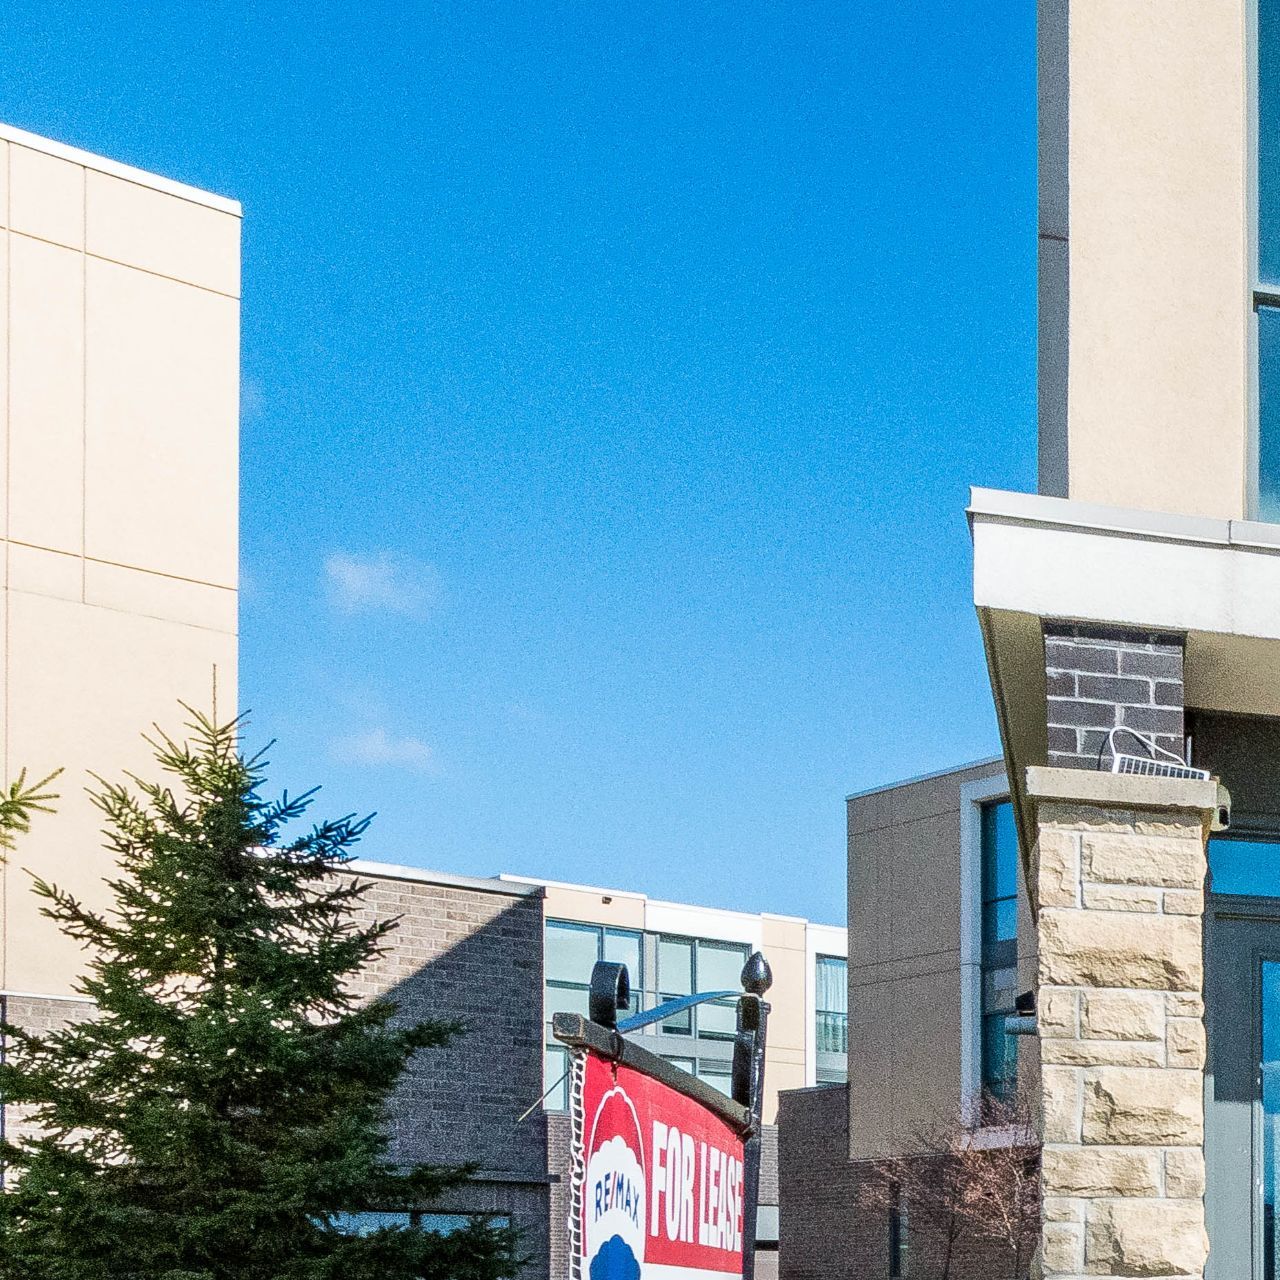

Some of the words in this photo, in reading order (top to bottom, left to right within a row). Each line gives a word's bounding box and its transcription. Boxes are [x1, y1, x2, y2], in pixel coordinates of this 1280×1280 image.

[595, 1171, 640, 1229] RE/MAX
[650, 1120, 696, 1244] FOR
[698, 1141, 743, 1253] LEASE
